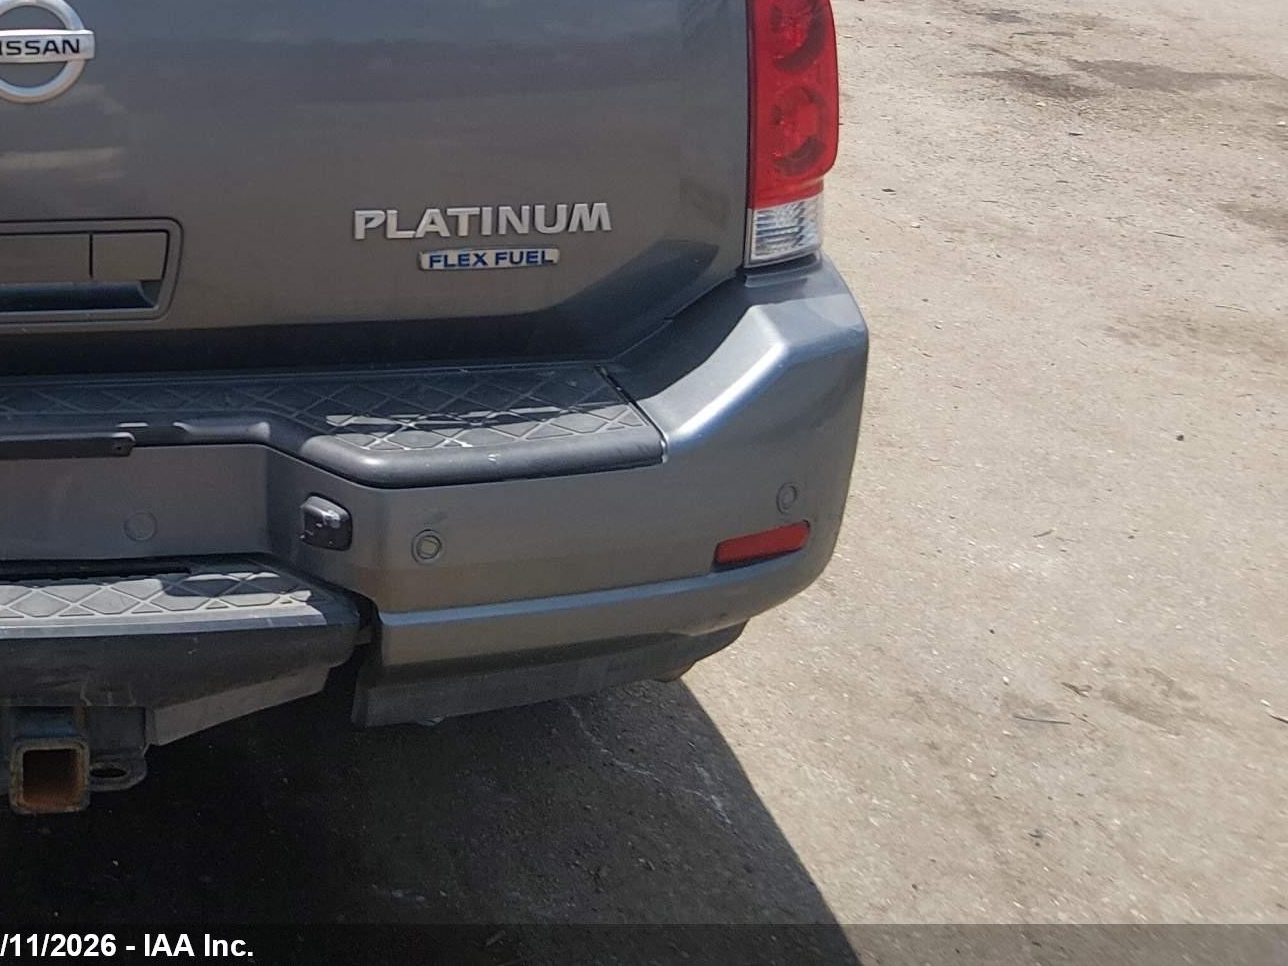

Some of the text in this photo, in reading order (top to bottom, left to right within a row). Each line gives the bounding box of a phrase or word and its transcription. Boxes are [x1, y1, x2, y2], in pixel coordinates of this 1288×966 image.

[353, 201, 612, 240] PLATINUM
[428, 249, 555, 269] FLEX FUEL
